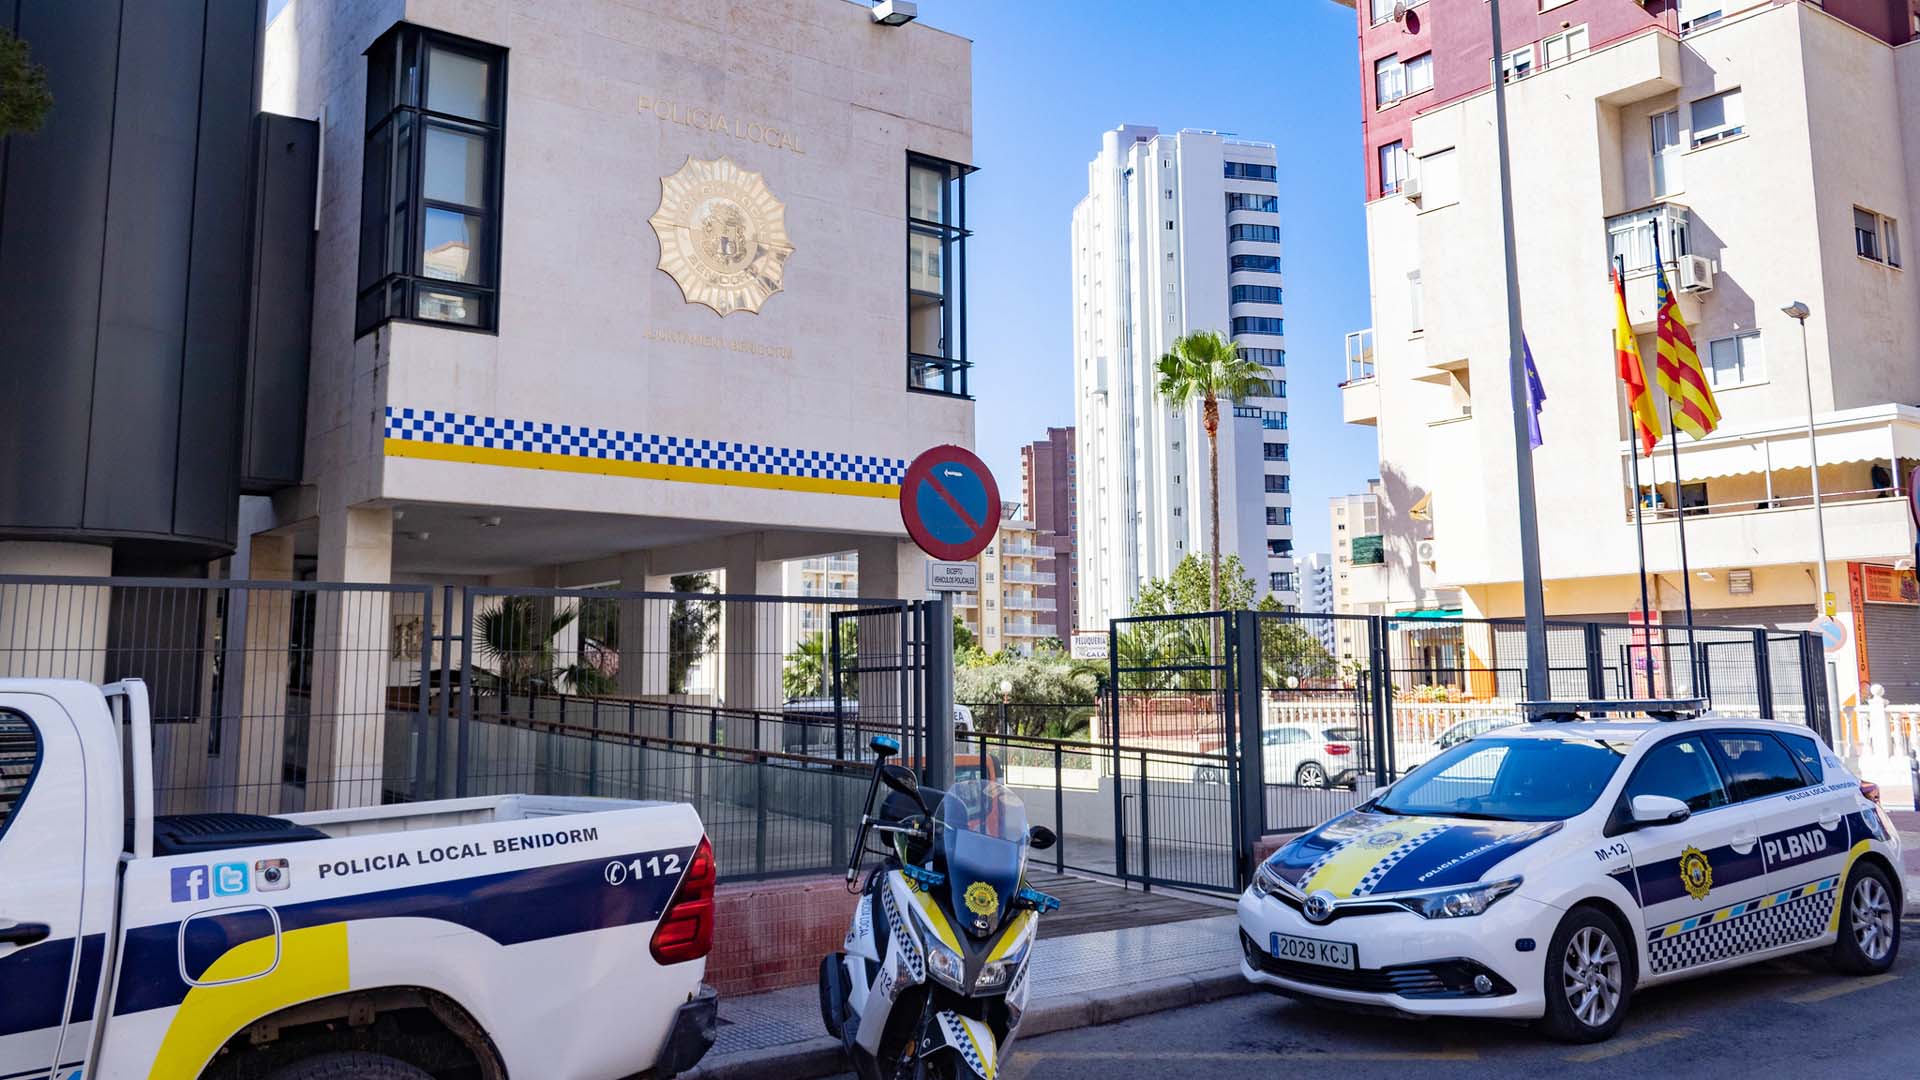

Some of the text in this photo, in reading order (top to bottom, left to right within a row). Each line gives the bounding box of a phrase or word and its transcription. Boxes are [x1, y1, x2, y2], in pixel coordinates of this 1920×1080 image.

[637, 95, 806, 154] POLICIA LOCAL
[1785, 791, 1811, 802] POLICIA
[1809, 785, 1830, 797] LOCAL
[319, 827, 599, 879] POLICIA LOCAL BENIDORM
[1594, 843, 1628, 861] M-12
[1764, 829, 1827, 865] PLBND
[628, 853, 682, 880] 112
[1418, 844, 1492, 882] POLICIA LOCAL
[1281, 938, 1349, 965] 2029 KCJ
